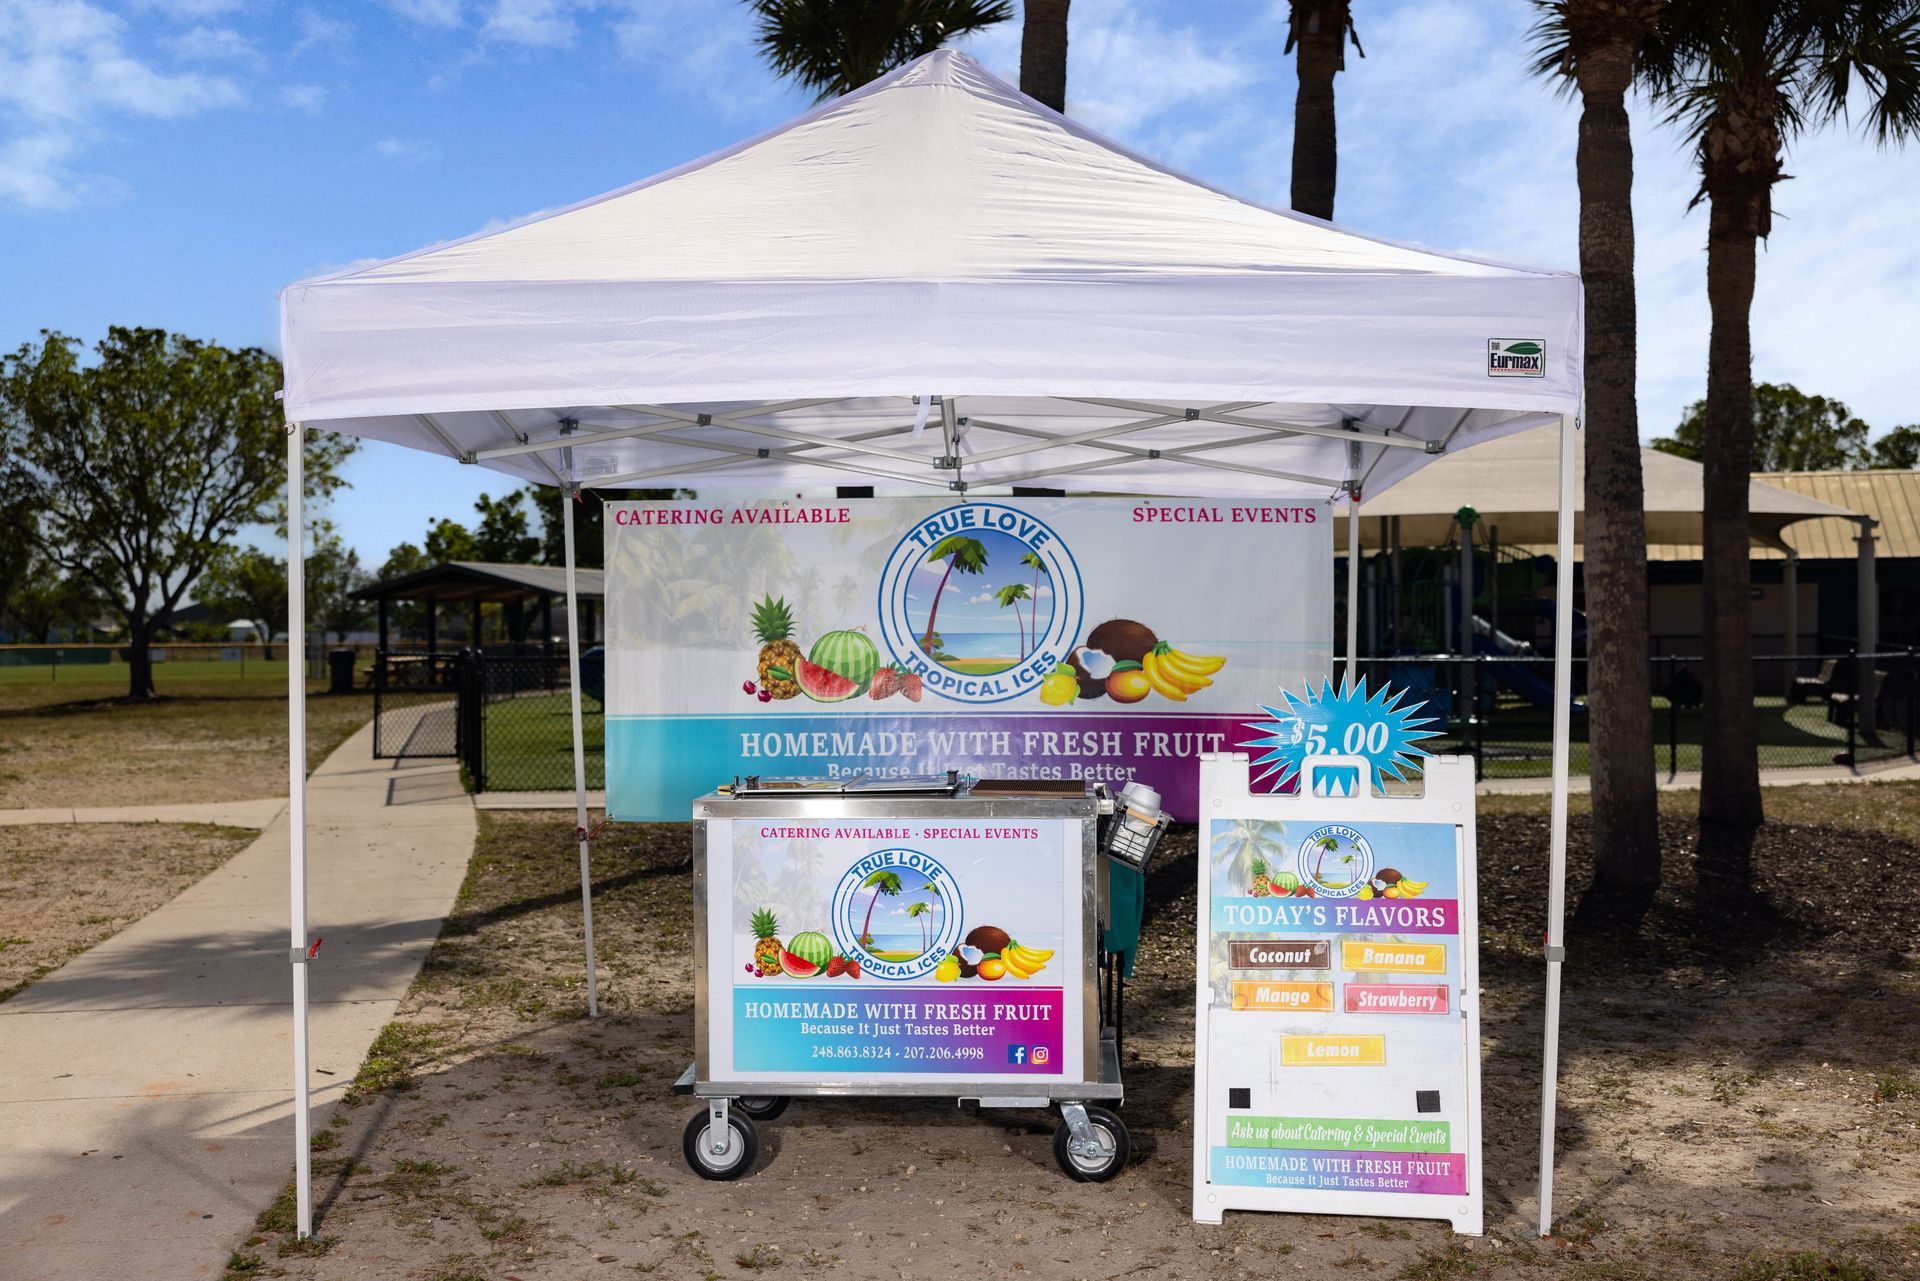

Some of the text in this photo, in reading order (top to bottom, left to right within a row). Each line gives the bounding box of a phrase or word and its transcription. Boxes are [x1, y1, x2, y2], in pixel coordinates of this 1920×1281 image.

[1490, 353, 1540, 369] Eurmax
[616, 508, 850, 525] CATERING AVAILABLE
[1133, 507, 1317, 524] SPECIAL EVENTS
[909, 509, 1050, 550] TRUE LOVE
[904, 651, 1057, 697] TROPICAL ICES
[740, 731, 1225, 758] HOMEMADE WITH FRESH FRUIT
[1291, 718, 1389, 755] $5.00
[827, 763, 910, 777] Because
[992, 763, 1062, 780] Tastes
[1070, 763, 1136, 781] Better
[761, 827, 830, 839] CATERING
[834, 827, 911, 839] AVAILABLE
[923, 828, 980, 839] SPECIAL
[985, 828, 1039, 839] EVENTS
[1309, 827, 1362, 843] TRUE LOVE
[851, 852, 943, 881] TRUE LOVE
[1307, 879, 1365, 897] TROPICAL ICES
[1224, 905, 1445, 927] TODAY'S FLAVORS
[848, 945, 947, 976] TROPICAL ICES
[1250, 948, 1311, 963] Coconut
[1363, 950, 1425, 965] Banana
[1256, 987, 1310, 1006] Mango
[1359, 991, 1437, 1013] Strawberry
[745, 1002, 1052, 1021] HOMEMADE WITH FRESH FRUIT
[800, 1023, 996, 1037] Because It Just Tastes Better
[812, 1045, 892, 1059] 248.863.8324
[903, 1047, 984, 1060] 207.206.4998
[1307, 1041, 1360, 1057] Lemon
[1231, 1121, 1447, 1148] Ask us about Catering & Special Events
[1225, 1156, 1450, 1176] HOMEMADE WITH FRESH FRUIT
[1266, 1174, 1409, 1188] Because It Just Tastes Better
